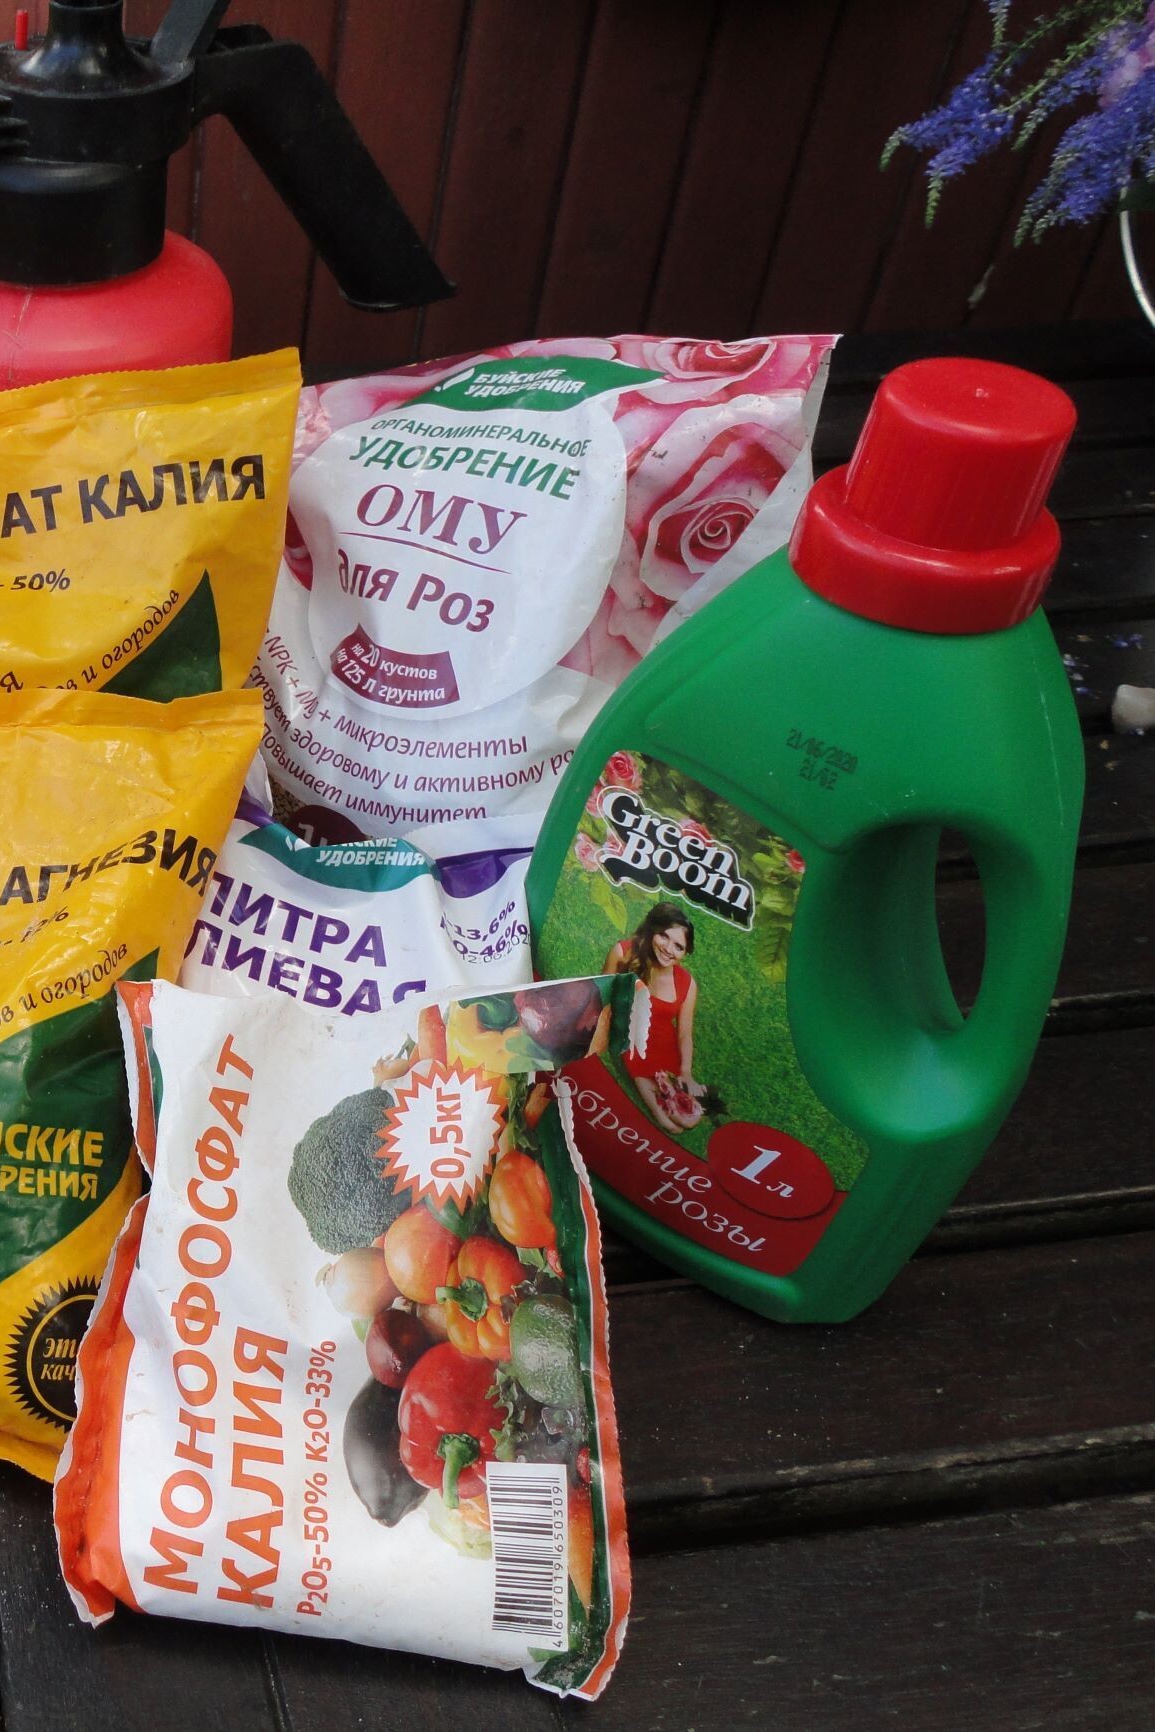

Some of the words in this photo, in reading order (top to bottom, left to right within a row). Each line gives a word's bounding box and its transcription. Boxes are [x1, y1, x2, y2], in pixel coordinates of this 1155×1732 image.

[464, 381, 586, 398] УДОБРЕНИЯ
[473, 368, 567, 384] БУЙСКИЕ
[348, 434, 582, 501] УДОБРЕНИЕ
[370, 418, 592, 459] ОРГАНОМИНЕРАЛЬНОЕ
[78, 454, 267, 524] КАЛИЯ
[356, 483, 528, 556] ОМУ
[10, 569, 71, 593] 50%
[82, 665, 98, 684] и
[101, 589, 181, 671] огородов
[264, 635, 298, 676] NPK
[363, 644, 380, 668] 20
[380, 659, 438, 680] кустов
[342, 657, 365, 684] 125
[378, 686, 446, 704] грунта
[250, 665, 292, 733] ствует
[290, 727, 391, 790] здоровому
[393, 773, 409, 790] и
[413, 761, 545, 793] активному
[550, 750, 575, 776] ро
[345, 794, 487, 825] иммунитет
[601, 790, 735, 878] Green
[316, 849, 426, 867] УДОБРЕНИЯ
[622, 831, 752, 912] Boom
[21, 990, 37, 1011] и
[41, 943, 129, 1006] огородов
[554, 1070, 713, 1194] обрение
[730, 1144, 782, 1185] 1
[644, 1181, 768, 1253] розы
[42, 1336, 77, 1359] эт
[143, 1033, 255, 1597] МОНОФОСФАТ
[216, 1325, 289, 1610] КАЛИЯ
